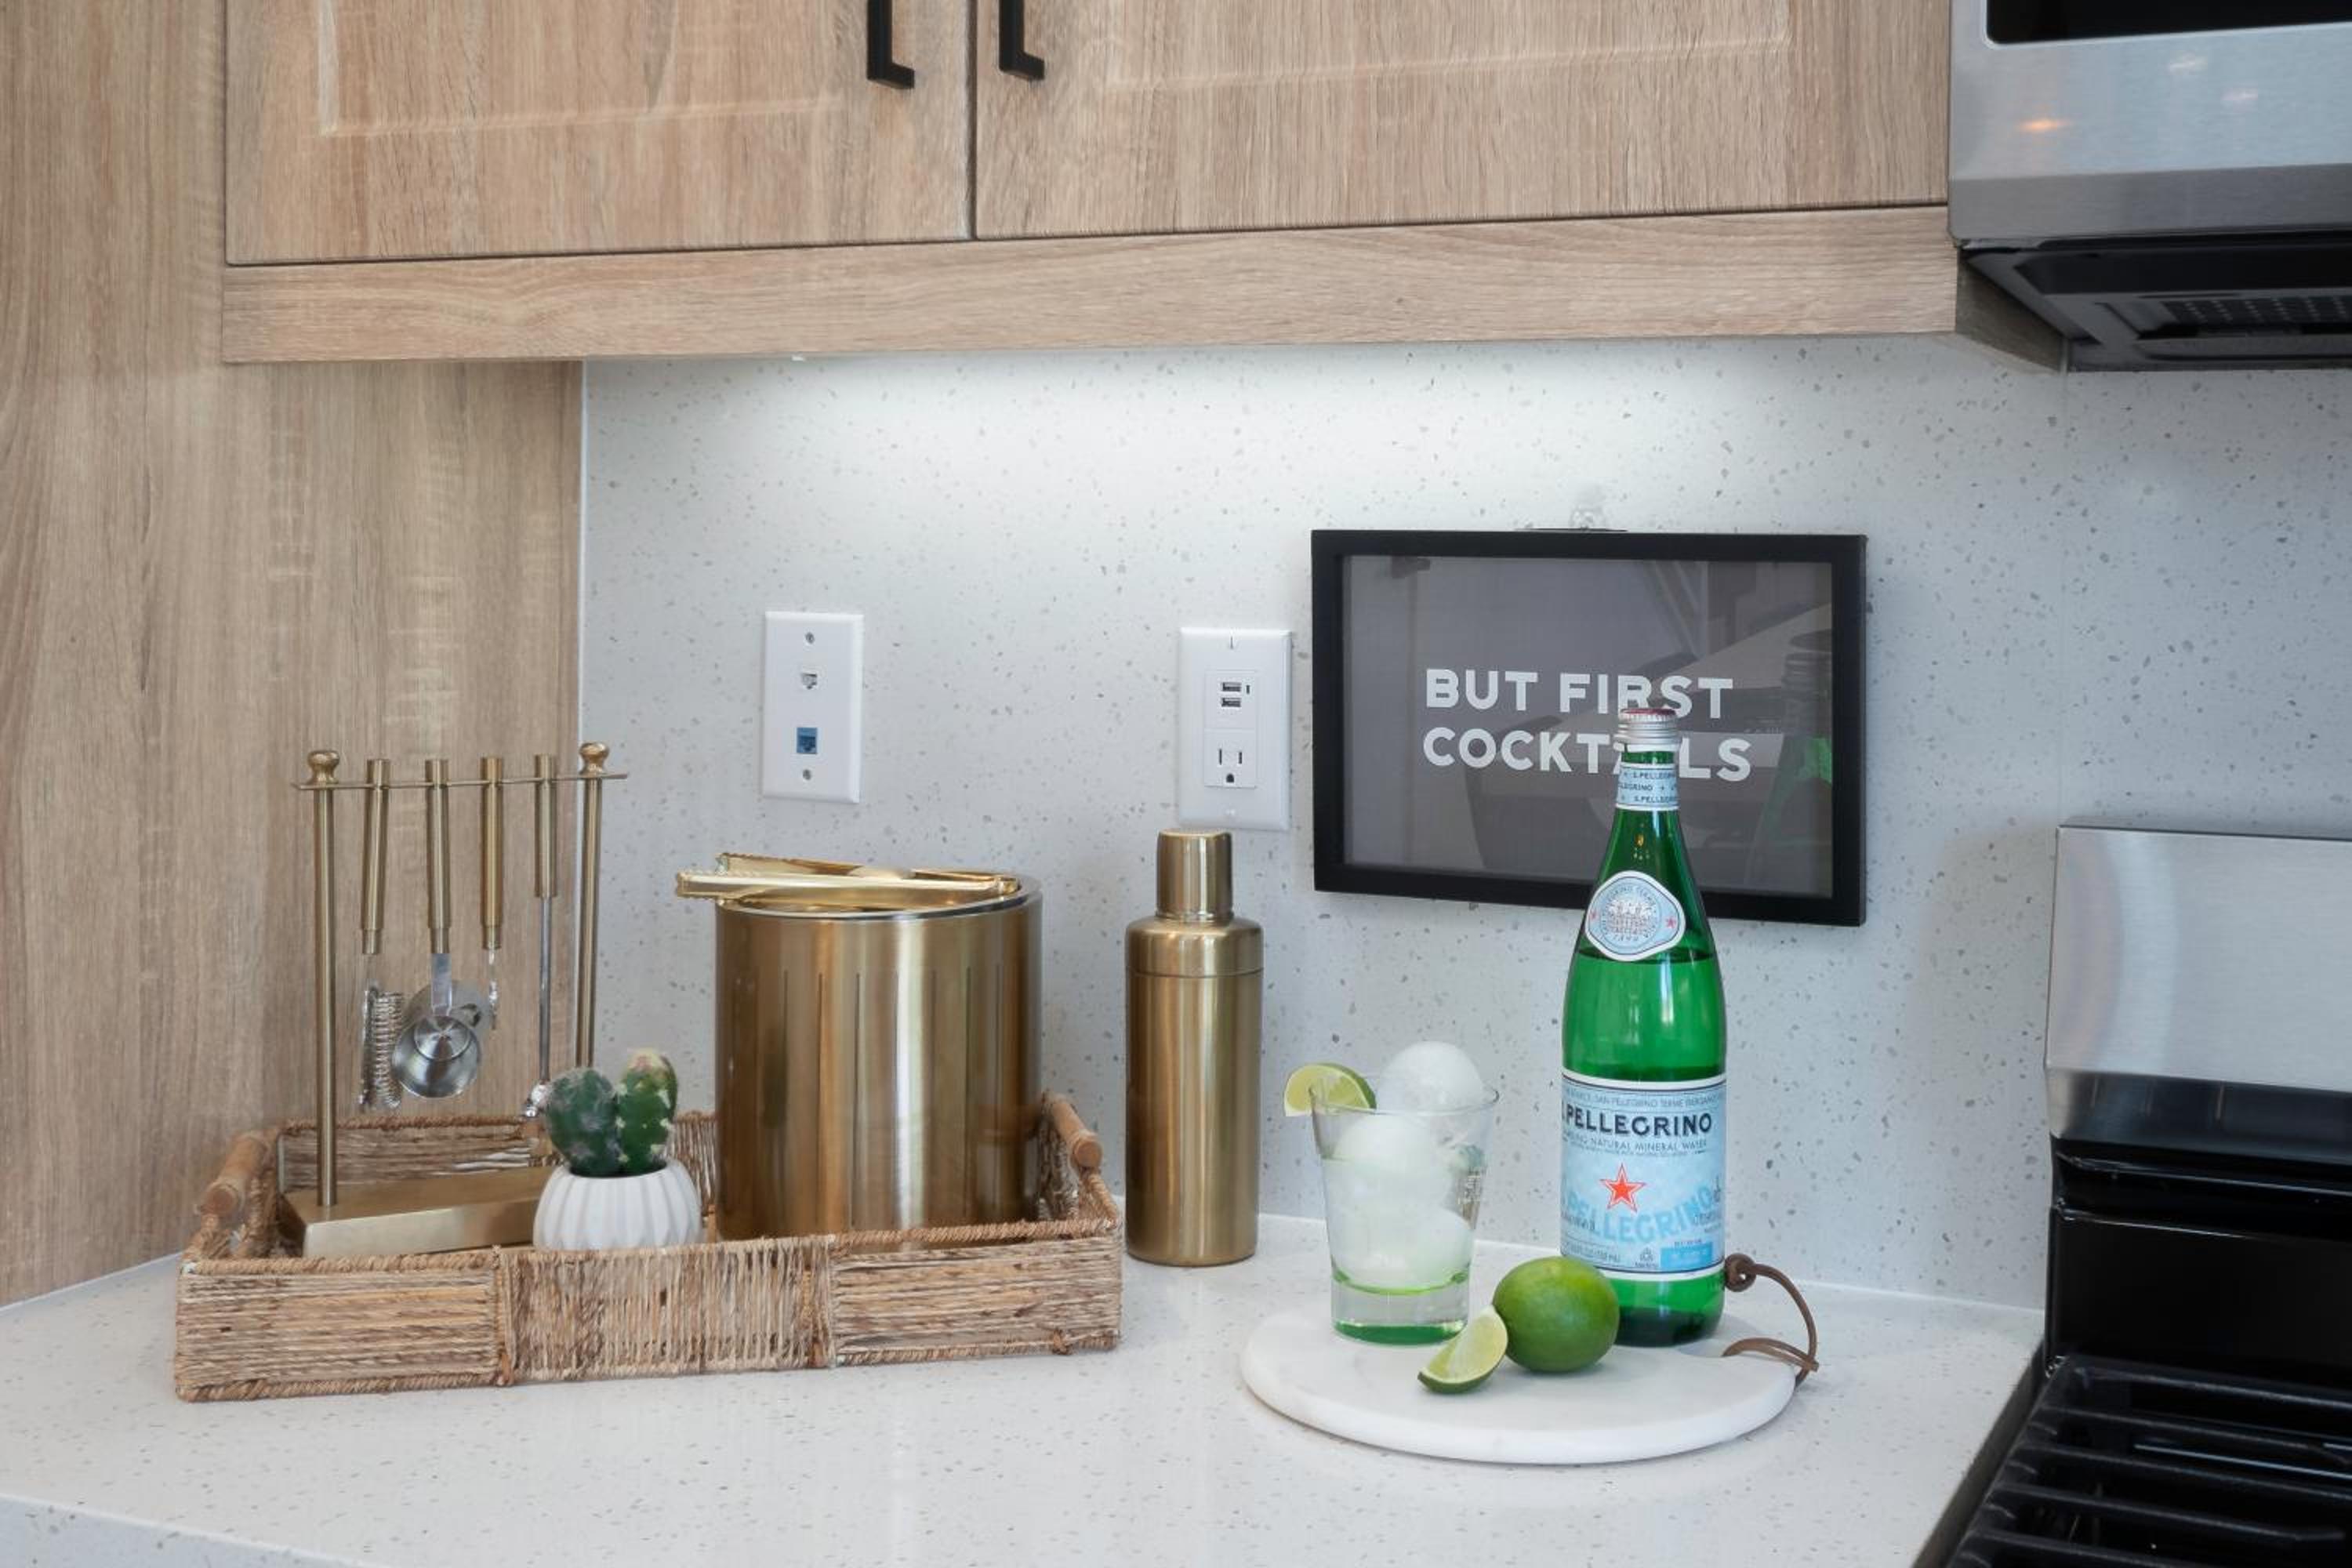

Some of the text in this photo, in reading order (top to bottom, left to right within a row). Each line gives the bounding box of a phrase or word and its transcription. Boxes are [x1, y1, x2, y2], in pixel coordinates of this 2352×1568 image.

[1426, 669, 1733, 719] BUT FIRST
[1423, 726, 1751, 782] COCKTLS
[1635, 1142, 1678, 1152] MINERAL
